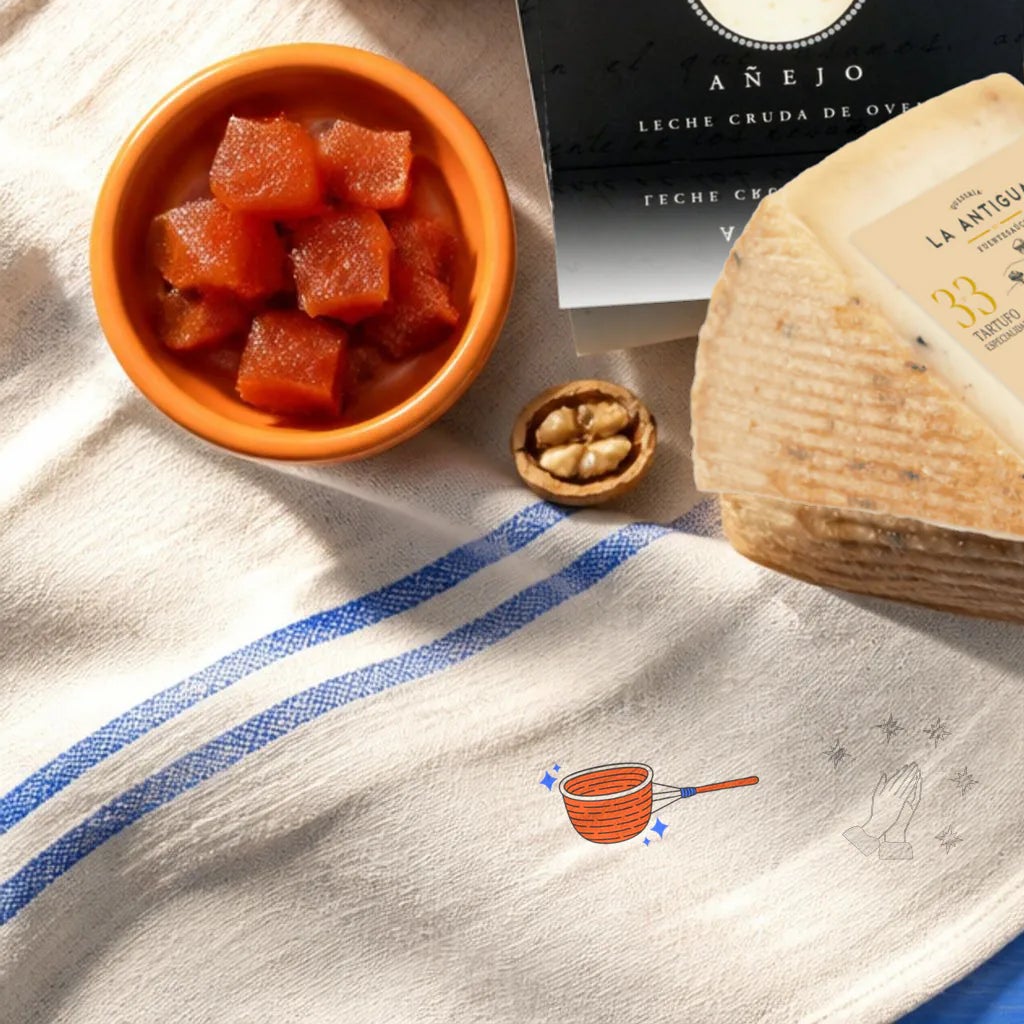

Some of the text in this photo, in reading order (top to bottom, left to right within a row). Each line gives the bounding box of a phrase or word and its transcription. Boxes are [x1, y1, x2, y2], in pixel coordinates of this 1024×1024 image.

[709, 64, 863, 92] AÑEJO
[638, 115, 714, 133] LECHE
[728, 109, 808, 126] CRUDA
[823, 105, 851, 119] DE
[925, 228, 956, 249] LA
[930, 275, 998, 329] 33
[972, 308, 1022, 342] TARTUFO
